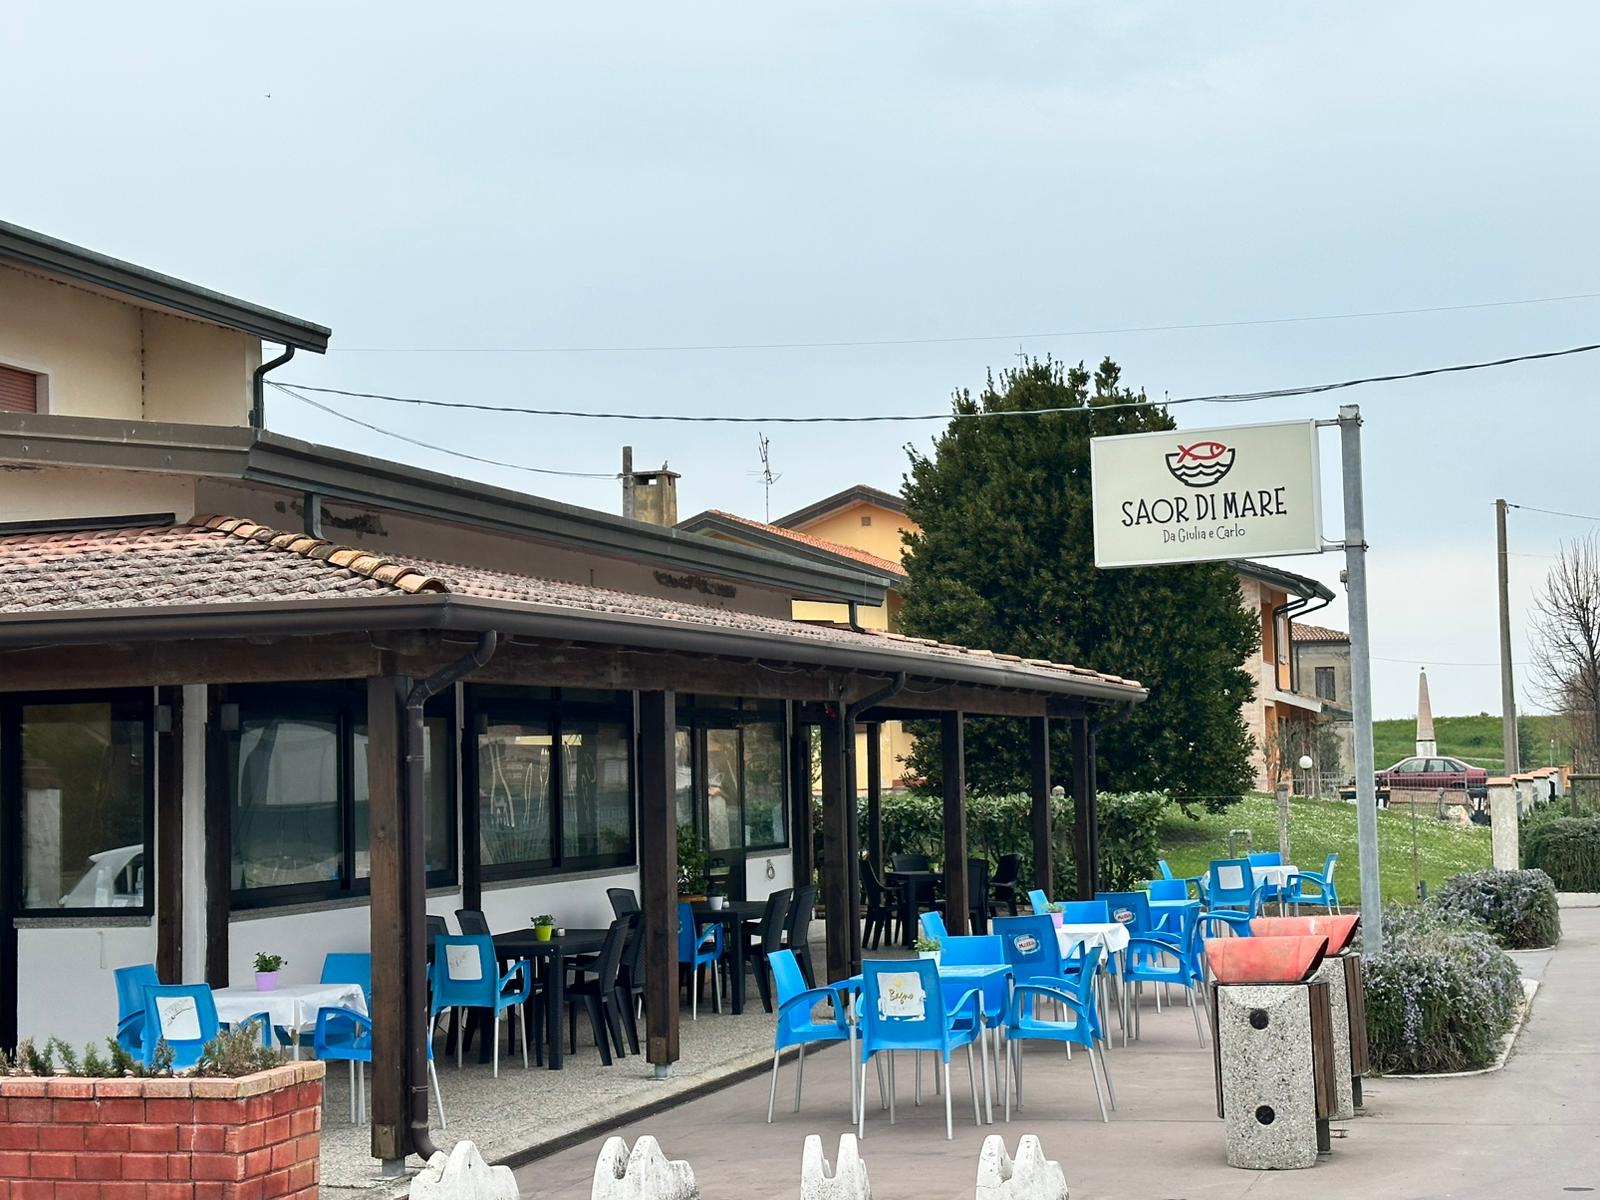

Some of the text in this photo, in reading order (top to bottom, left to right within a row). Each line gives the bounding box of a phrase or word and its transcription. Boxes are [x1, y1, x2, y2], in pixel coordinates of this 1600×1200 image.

[1121, 486, 1287, 527] SAOR DI MARE
[1163, 524, 1245, 543] Da Giulia e Carlo
